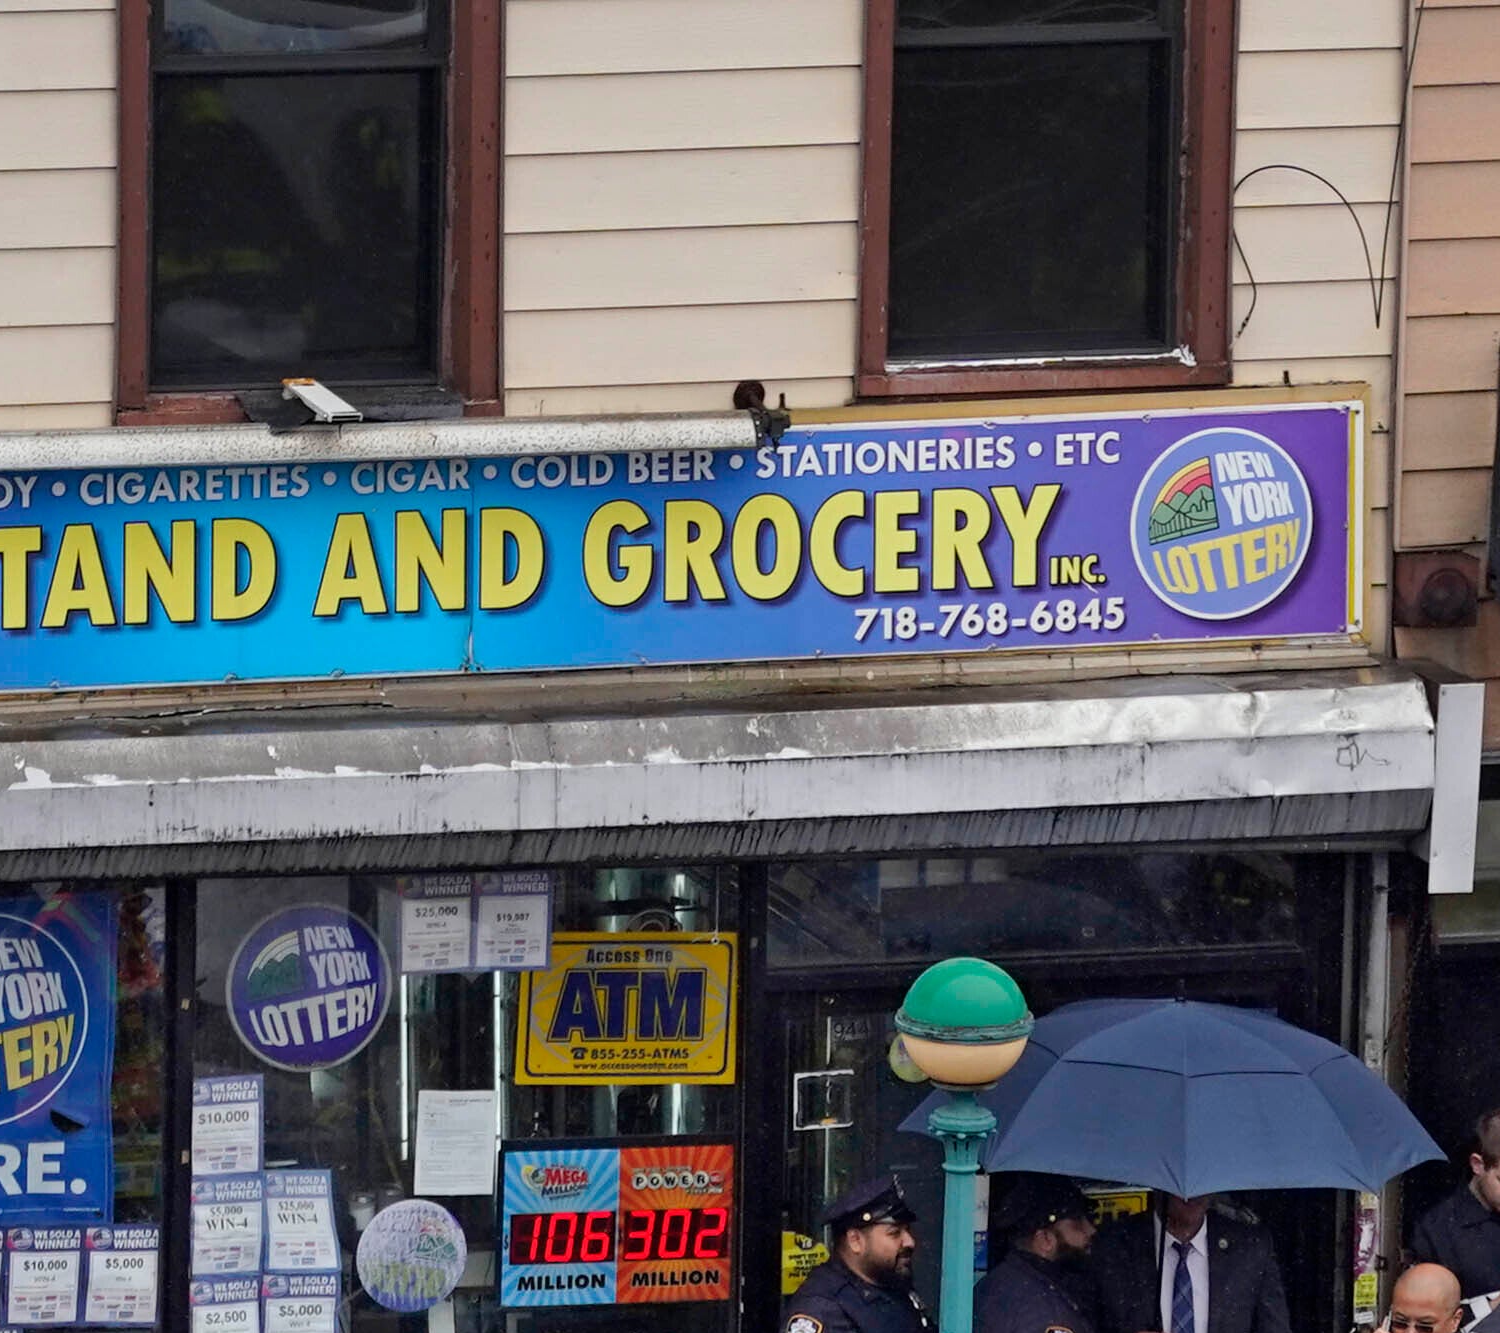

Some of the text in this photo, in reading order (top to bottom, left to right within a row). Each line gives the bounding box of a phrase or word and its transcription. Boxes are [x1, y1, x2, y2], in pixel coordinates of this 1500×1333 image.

[79, 464, 310, 506] CIGARETTES
[351, 458, 469, 494] CIGAR
[511, 455, 612, 488] COLD
[627, 451, 714, 482] BEER
[755, 435, 1015, 478] STATIONERIES
[1054, 432, 1120, 466] ETC
[1215, 451, 1294, 522] NEW YORK
[312, 504, 546, 617] AND
[582, 483, 1062, 608] GROCERY
[1050, 552, 1106, 587] INC.
[1152, 516, 1301, 597] LOTTERY
[854, 596, 1125, 643] 718-768-6845
[586, 948, 673, 964] Access One
[547, 968, 707, 1042] ATM
[591, 1048, 689, 1060] 855-255-ATMS
[529, 1211, 613, 1263] 106
[625, 1207, 728, 1260] 302
[518, 1273, 605, 1292] MILLION
[632, 1270, 719, 1288] MILLION
